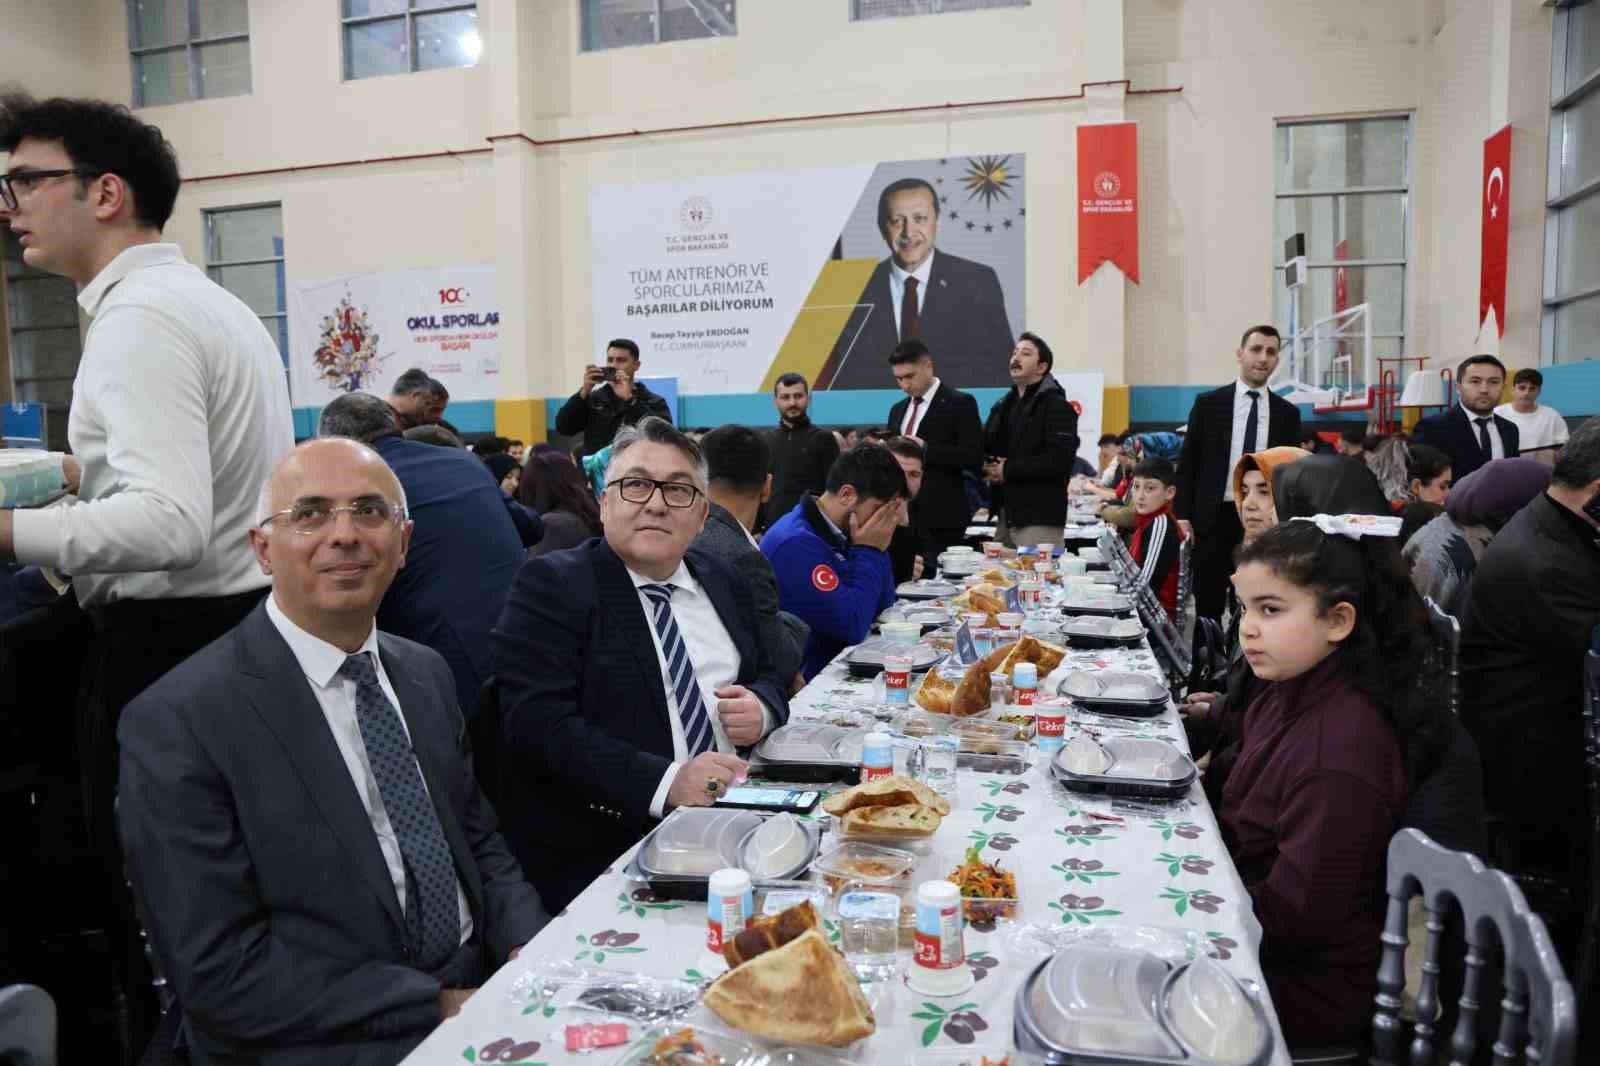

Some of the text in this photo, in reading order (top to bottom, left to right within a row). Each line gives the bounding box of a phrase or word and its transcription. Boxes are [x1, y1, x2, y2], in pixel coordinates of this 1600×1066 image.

[629, 260, 769, 284] TÜM ANTRENÖR VE
[633, 280, 765, 301] SPORCULARIMIZA
[626, 297, 774, 317] BAŞARILAR DİLİYORUM
[407, 316, 440, 330] OKUL
[650, 326, 749, 341] Recep Tayyip ERDOĞAN
